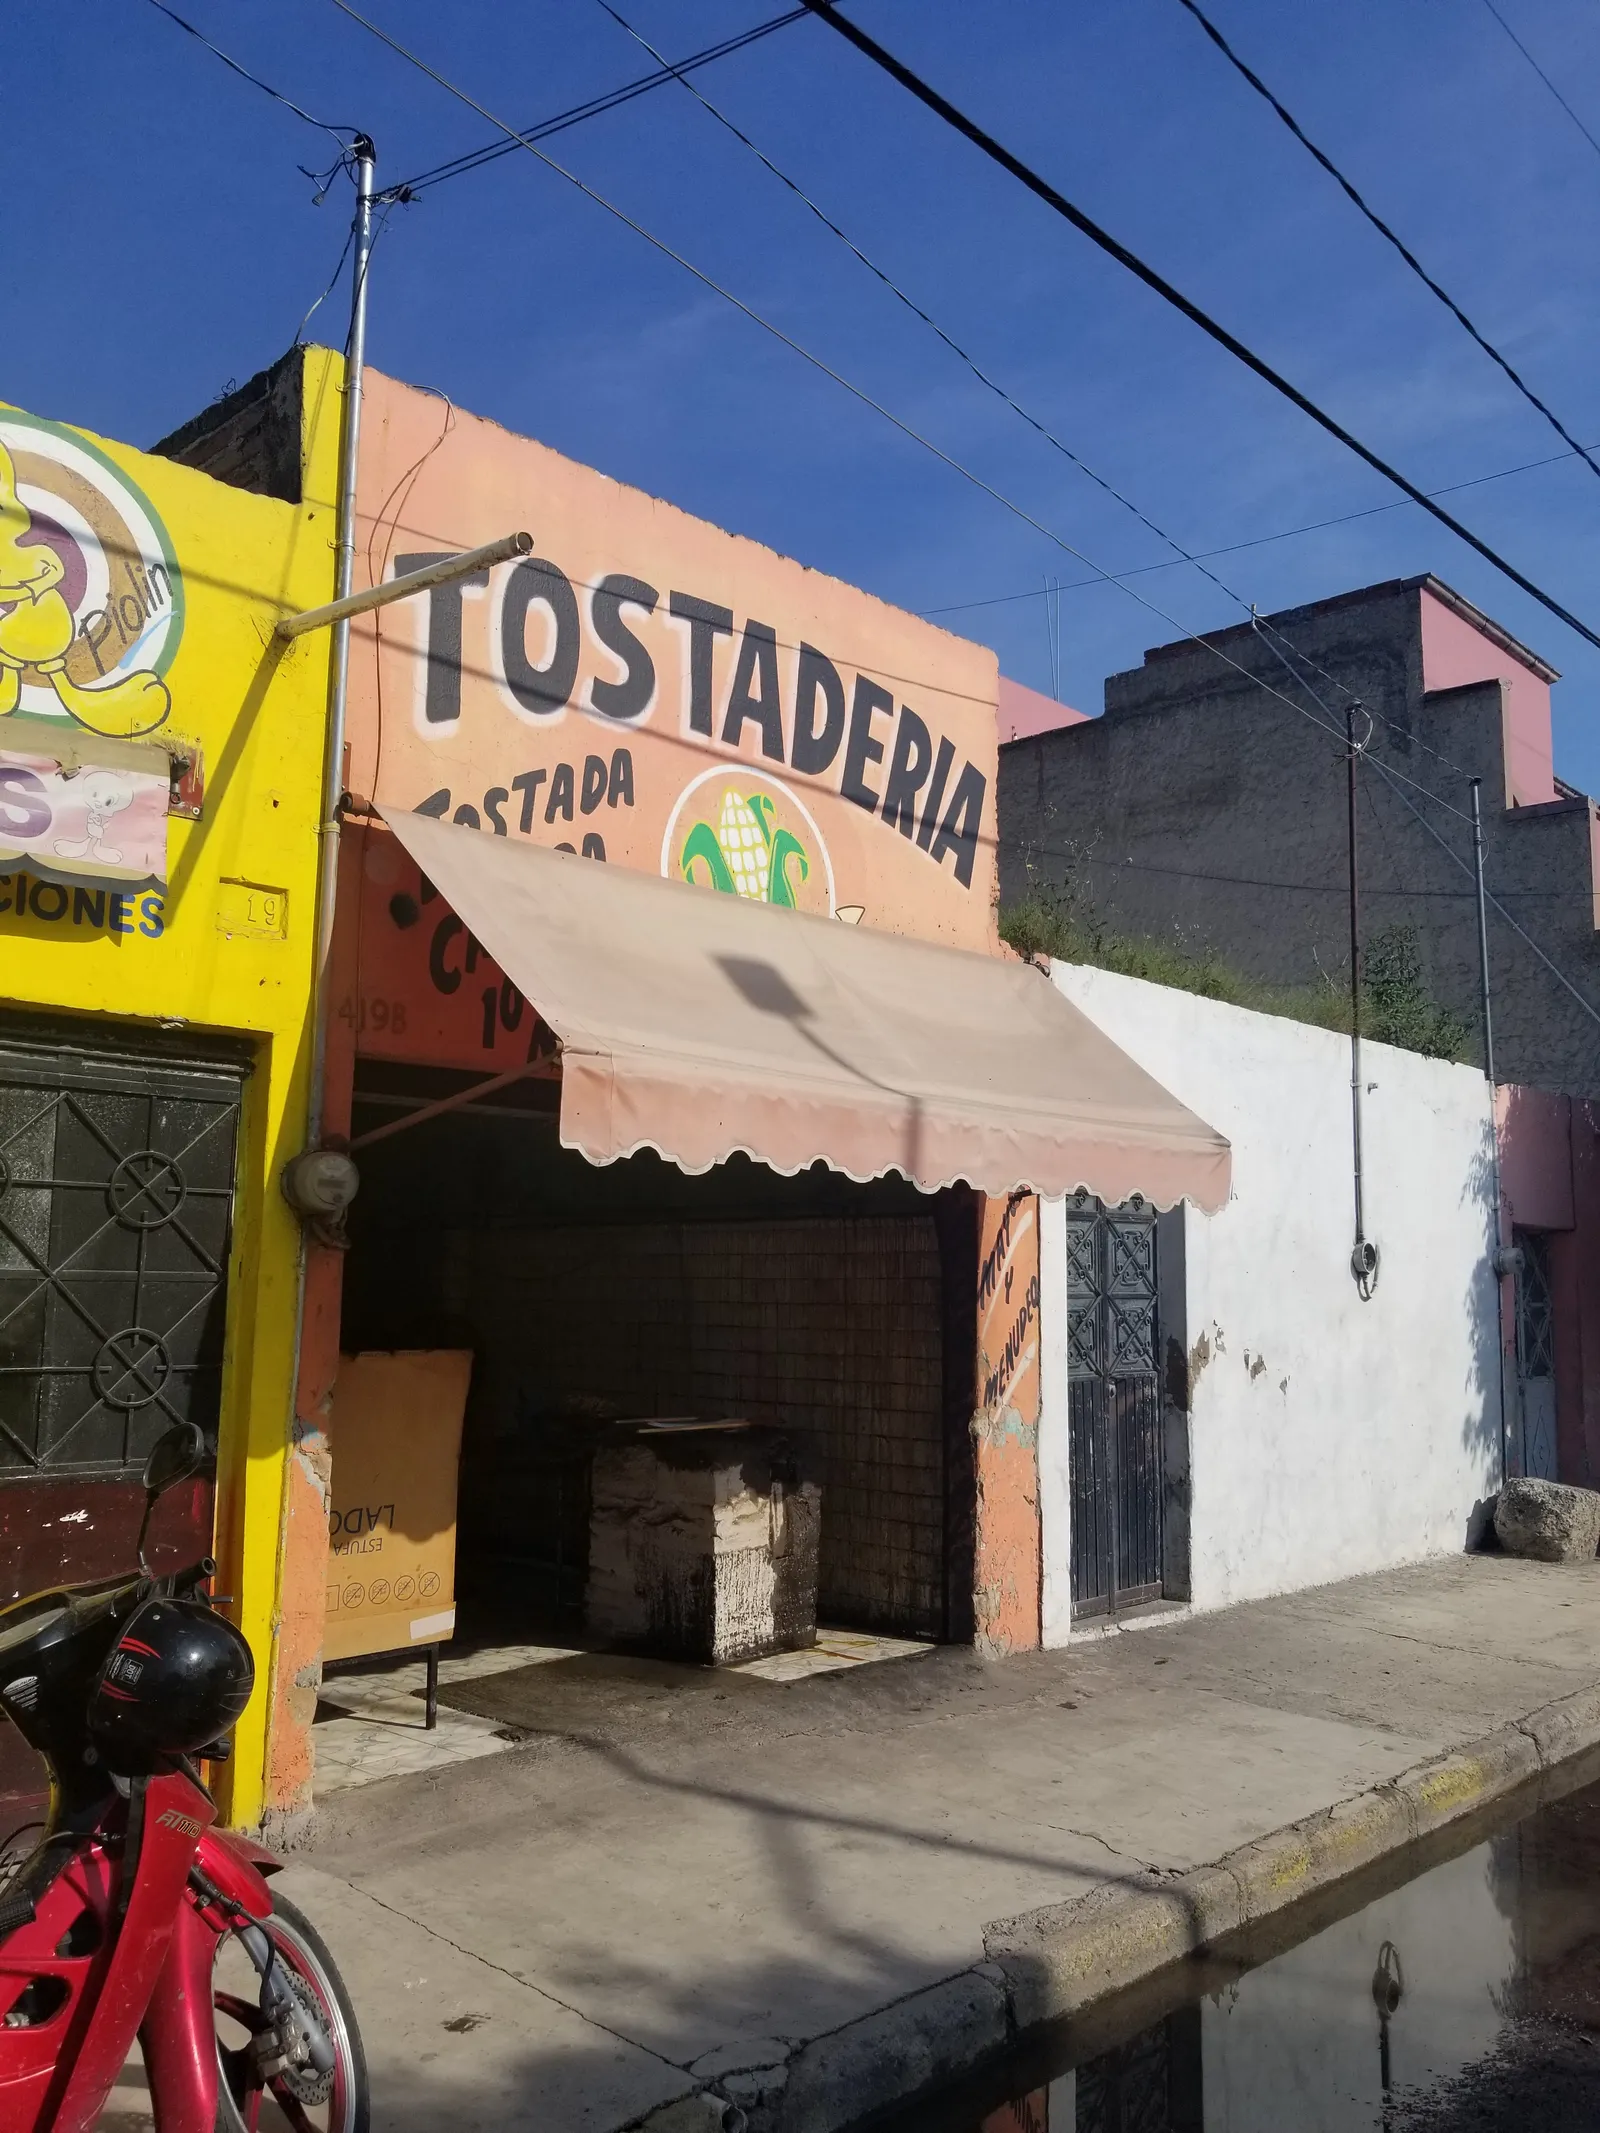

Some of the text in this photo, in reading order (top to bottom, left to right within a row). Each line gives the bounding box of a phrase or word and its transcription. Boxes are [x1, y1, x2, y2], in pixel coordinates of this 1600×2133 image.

[78, 562, 173, 676] Piolin
[395, 552, 987, 890] TOSTADERIA
[247, 893, 275, 926] 19
[1005, 1266, 1014, 1304] Y
[984, 1275, 1039, 1406] MENUDEO
[334, 1537, 383, 1556] ESTUFA
